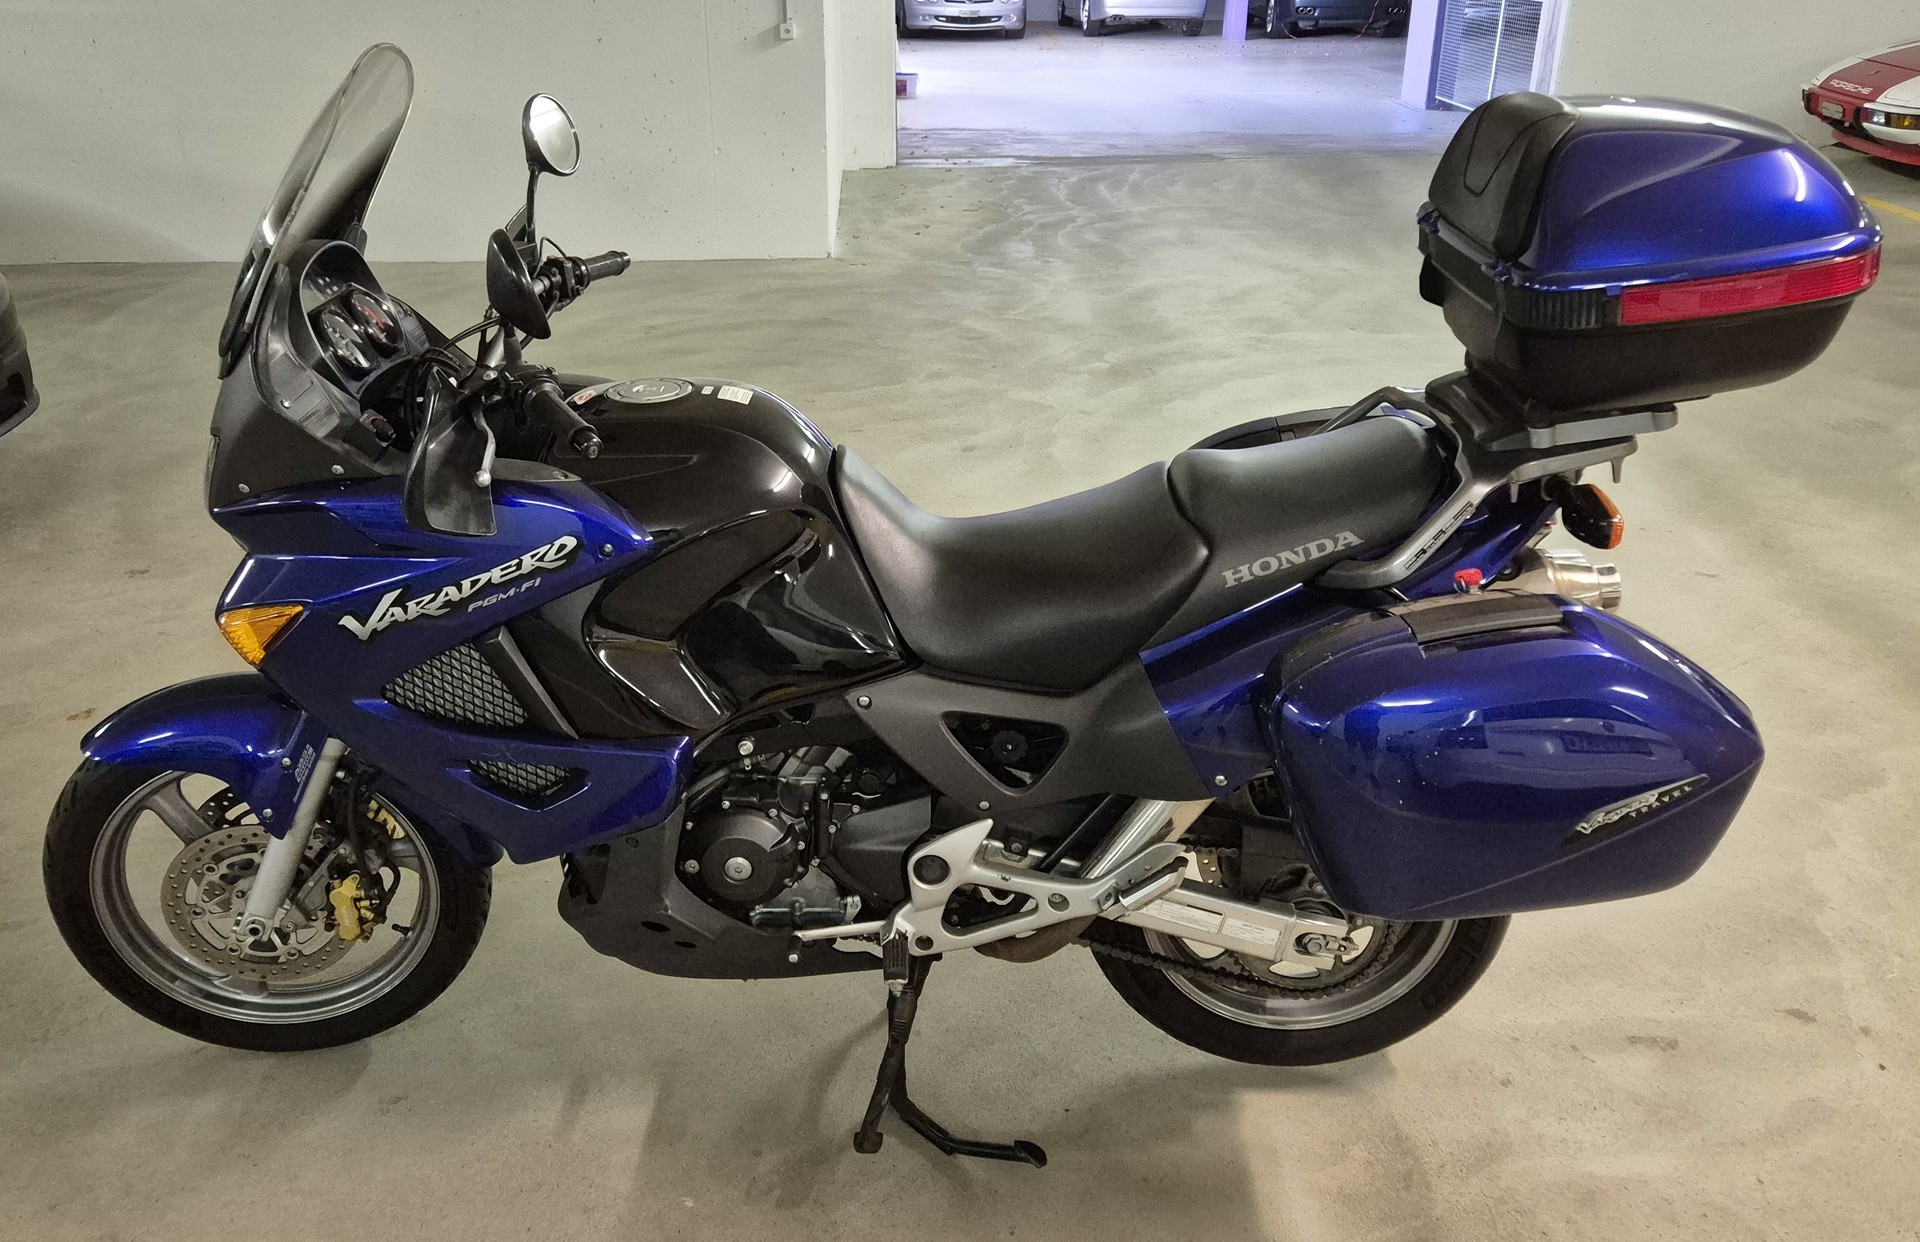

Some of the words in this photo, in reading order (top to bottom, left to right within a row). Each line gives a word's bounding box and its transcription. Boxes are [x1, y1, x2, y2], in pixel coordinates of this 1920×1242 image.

[1829, 79, 1874, 95] PORSCHE
[337, 535, 578, 641] VARADERO
[1221, 530, 1365, 588] HONDA
